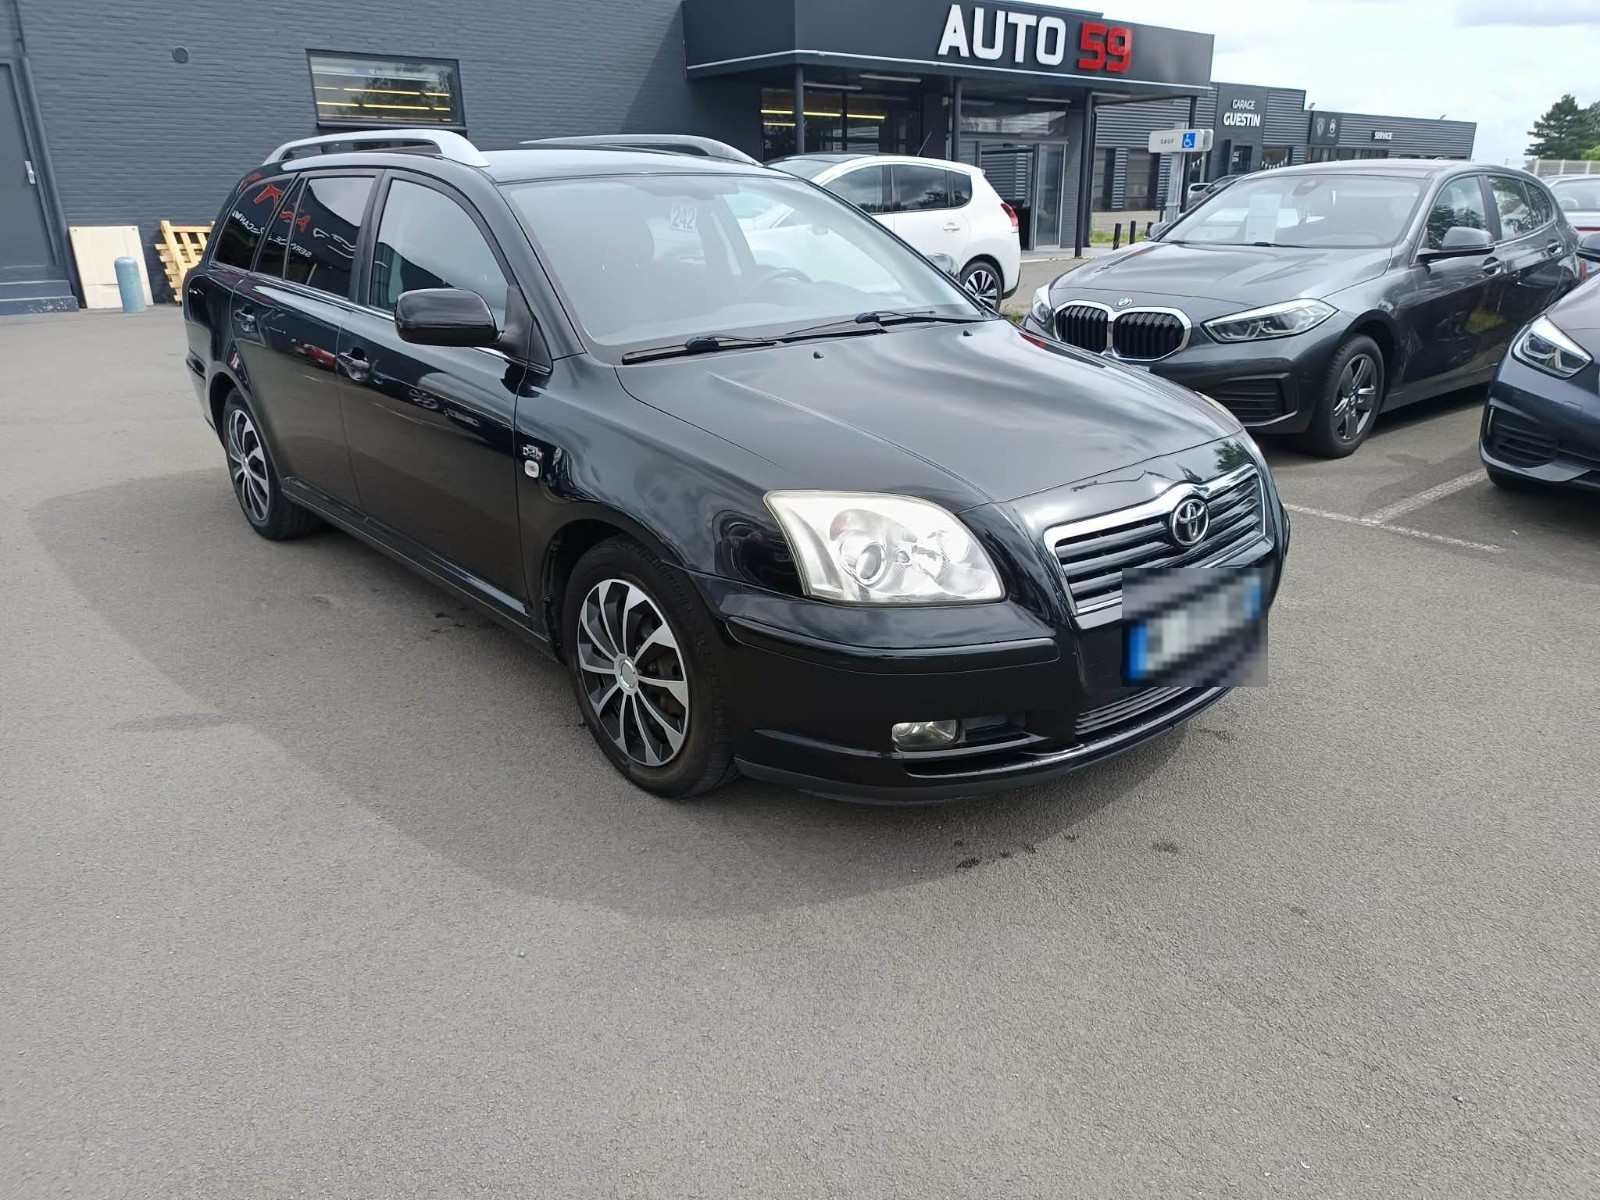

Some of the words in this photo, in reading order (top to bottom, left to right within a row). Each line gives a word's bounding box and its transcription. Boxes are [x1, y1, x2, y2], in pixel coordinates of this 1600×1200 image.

[938, 4, 1066, 66] AUTO
[1078, 22, 1132, 72] 59
[1232, 99, 1255, 110] GARAGE
[1223, 112, 1260, 127] GUESTIN
[1374, 131, 1393, 140] SERVICE
[671, 206, 696, 230] 242
